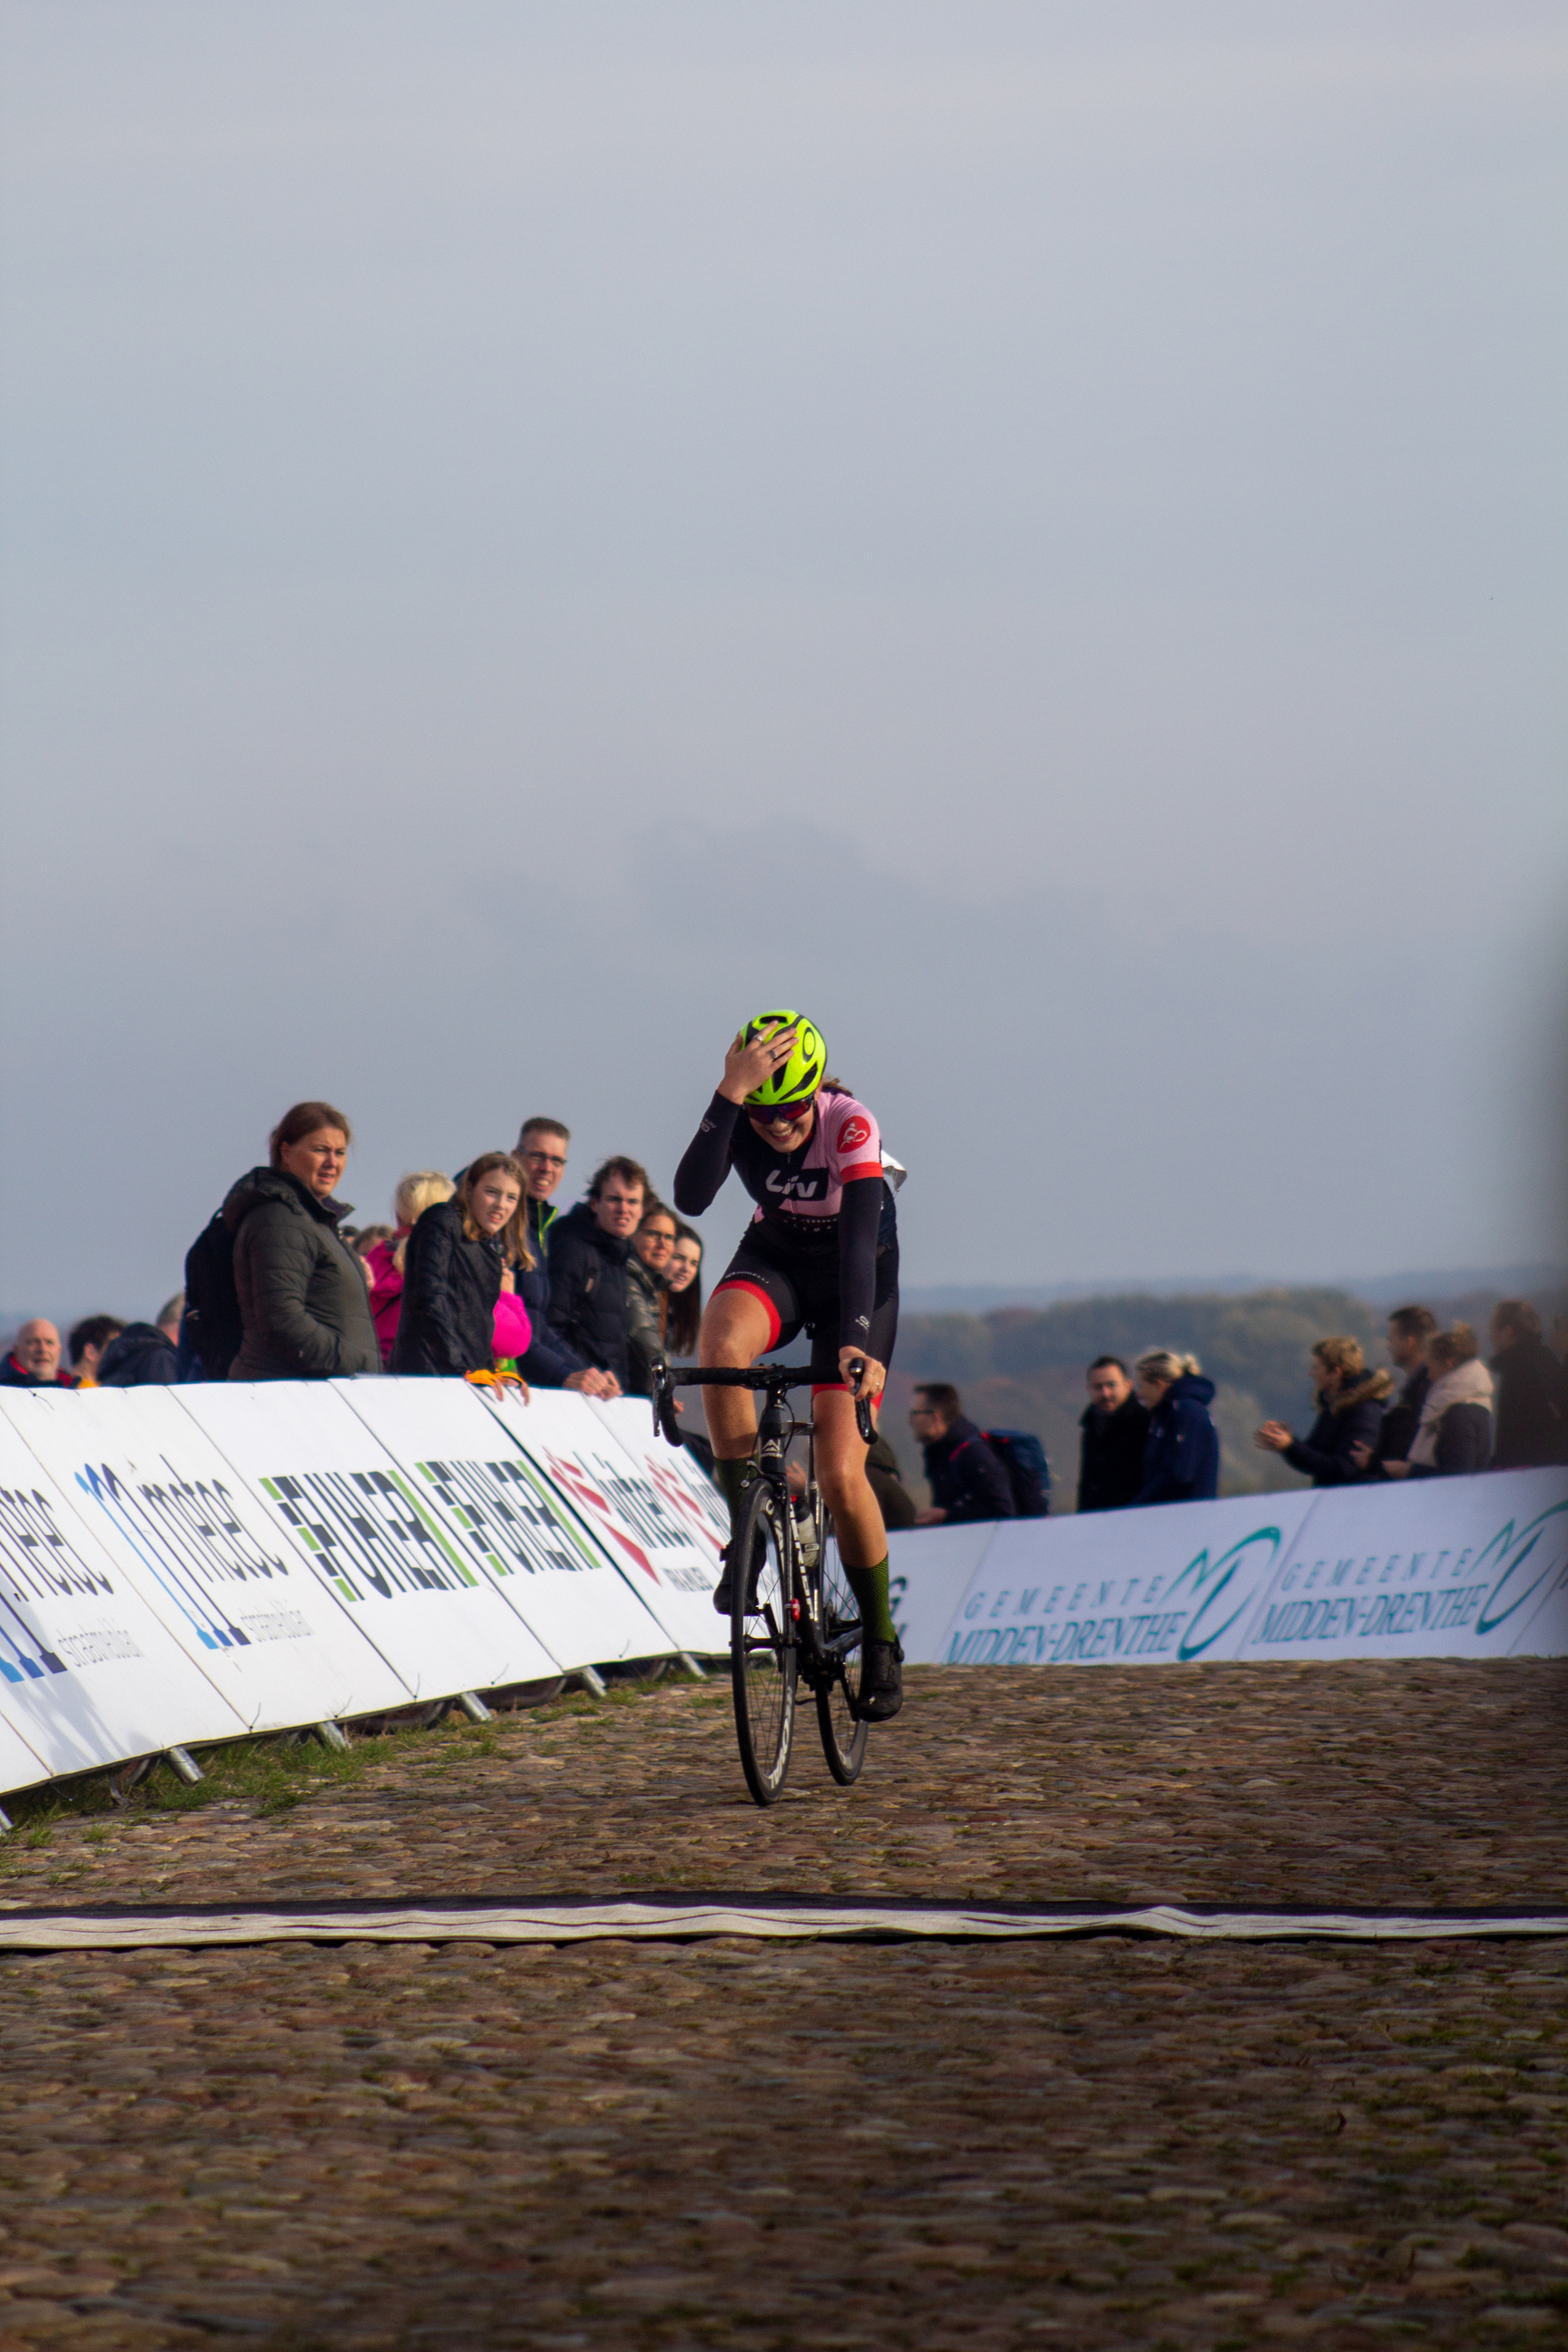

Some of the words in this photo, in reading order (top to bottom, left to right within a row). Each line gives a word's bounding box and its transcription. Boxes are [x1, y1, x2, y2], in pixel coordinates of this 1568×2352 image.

[765, 1169, 818, 1198] Liv
[136, 1454, 289, 1583] metec
[1280, 1548, 1474, 1592] GEMEENTE
[964, 1575, 1165, 1620] GEMEENTE
[1251, 1583, 1490, 1645] MIDDEN-DRENTHE
[941, 1611, 1189, 1665] MIDDEN-DRENTHE
